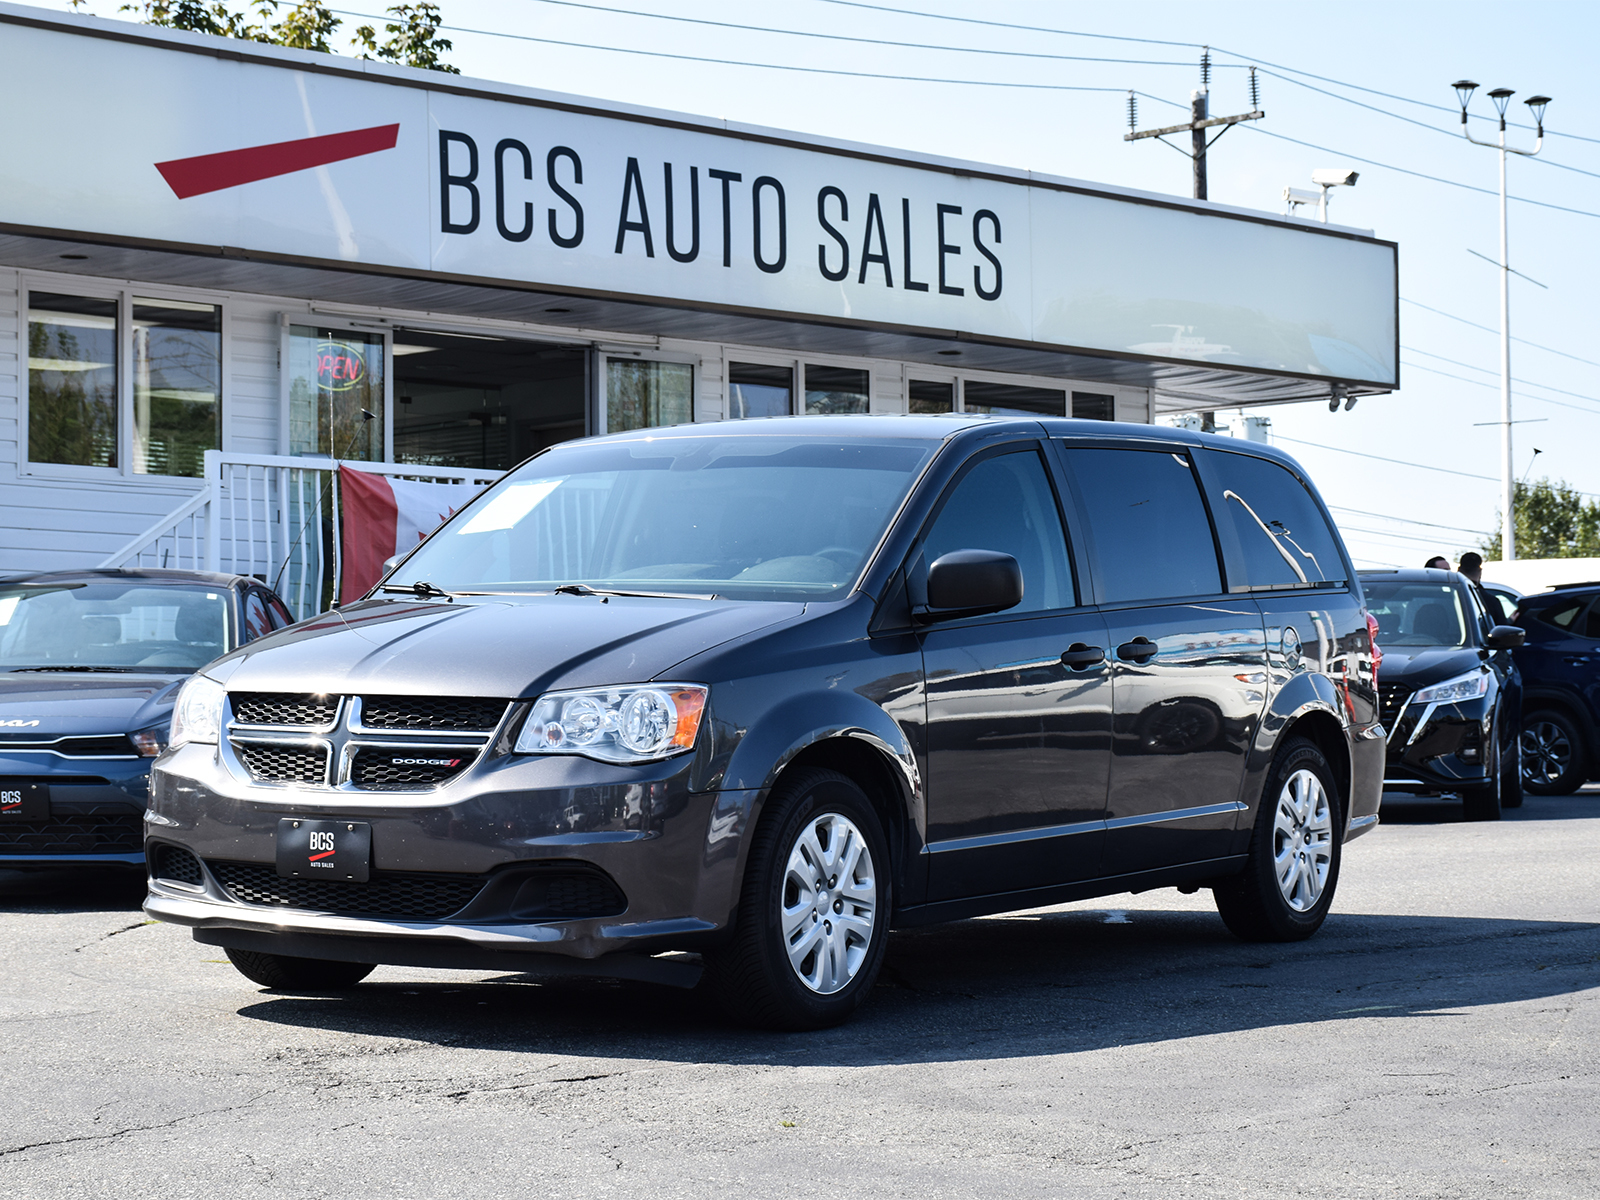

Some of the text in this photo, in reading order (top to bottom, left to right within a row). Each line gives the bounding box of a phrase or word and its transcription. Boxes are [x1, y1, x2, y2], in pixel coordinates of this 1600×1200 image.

[438, 129, 1003, 302] BCS AUTO SALES
[392, 758, 452, 766] DODGE
[1, 790, 22, 804] BCS
[310, 831, 335, 851] BCS
